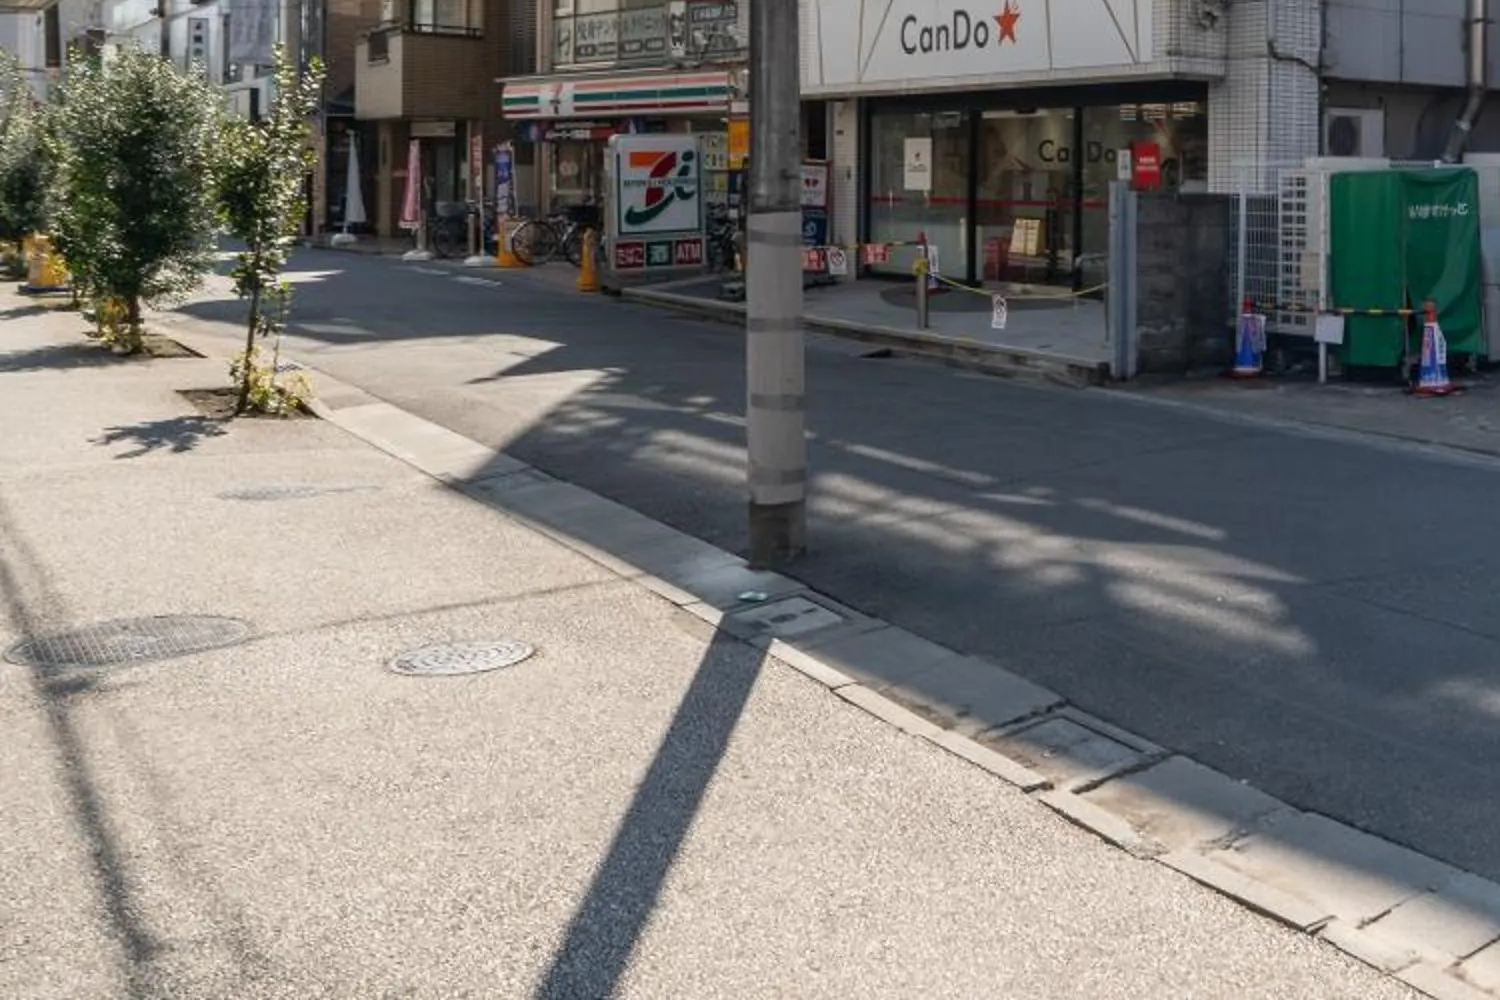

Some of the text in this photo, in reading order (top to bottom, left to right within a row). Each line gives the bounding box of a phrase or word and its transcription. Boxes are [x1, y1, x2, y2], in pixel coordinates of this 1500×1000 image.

[900, 9, 989, 55] CanDo
[1038, 139, 1119, 164] CaDo
[676, 242, 702, 262] ATM
